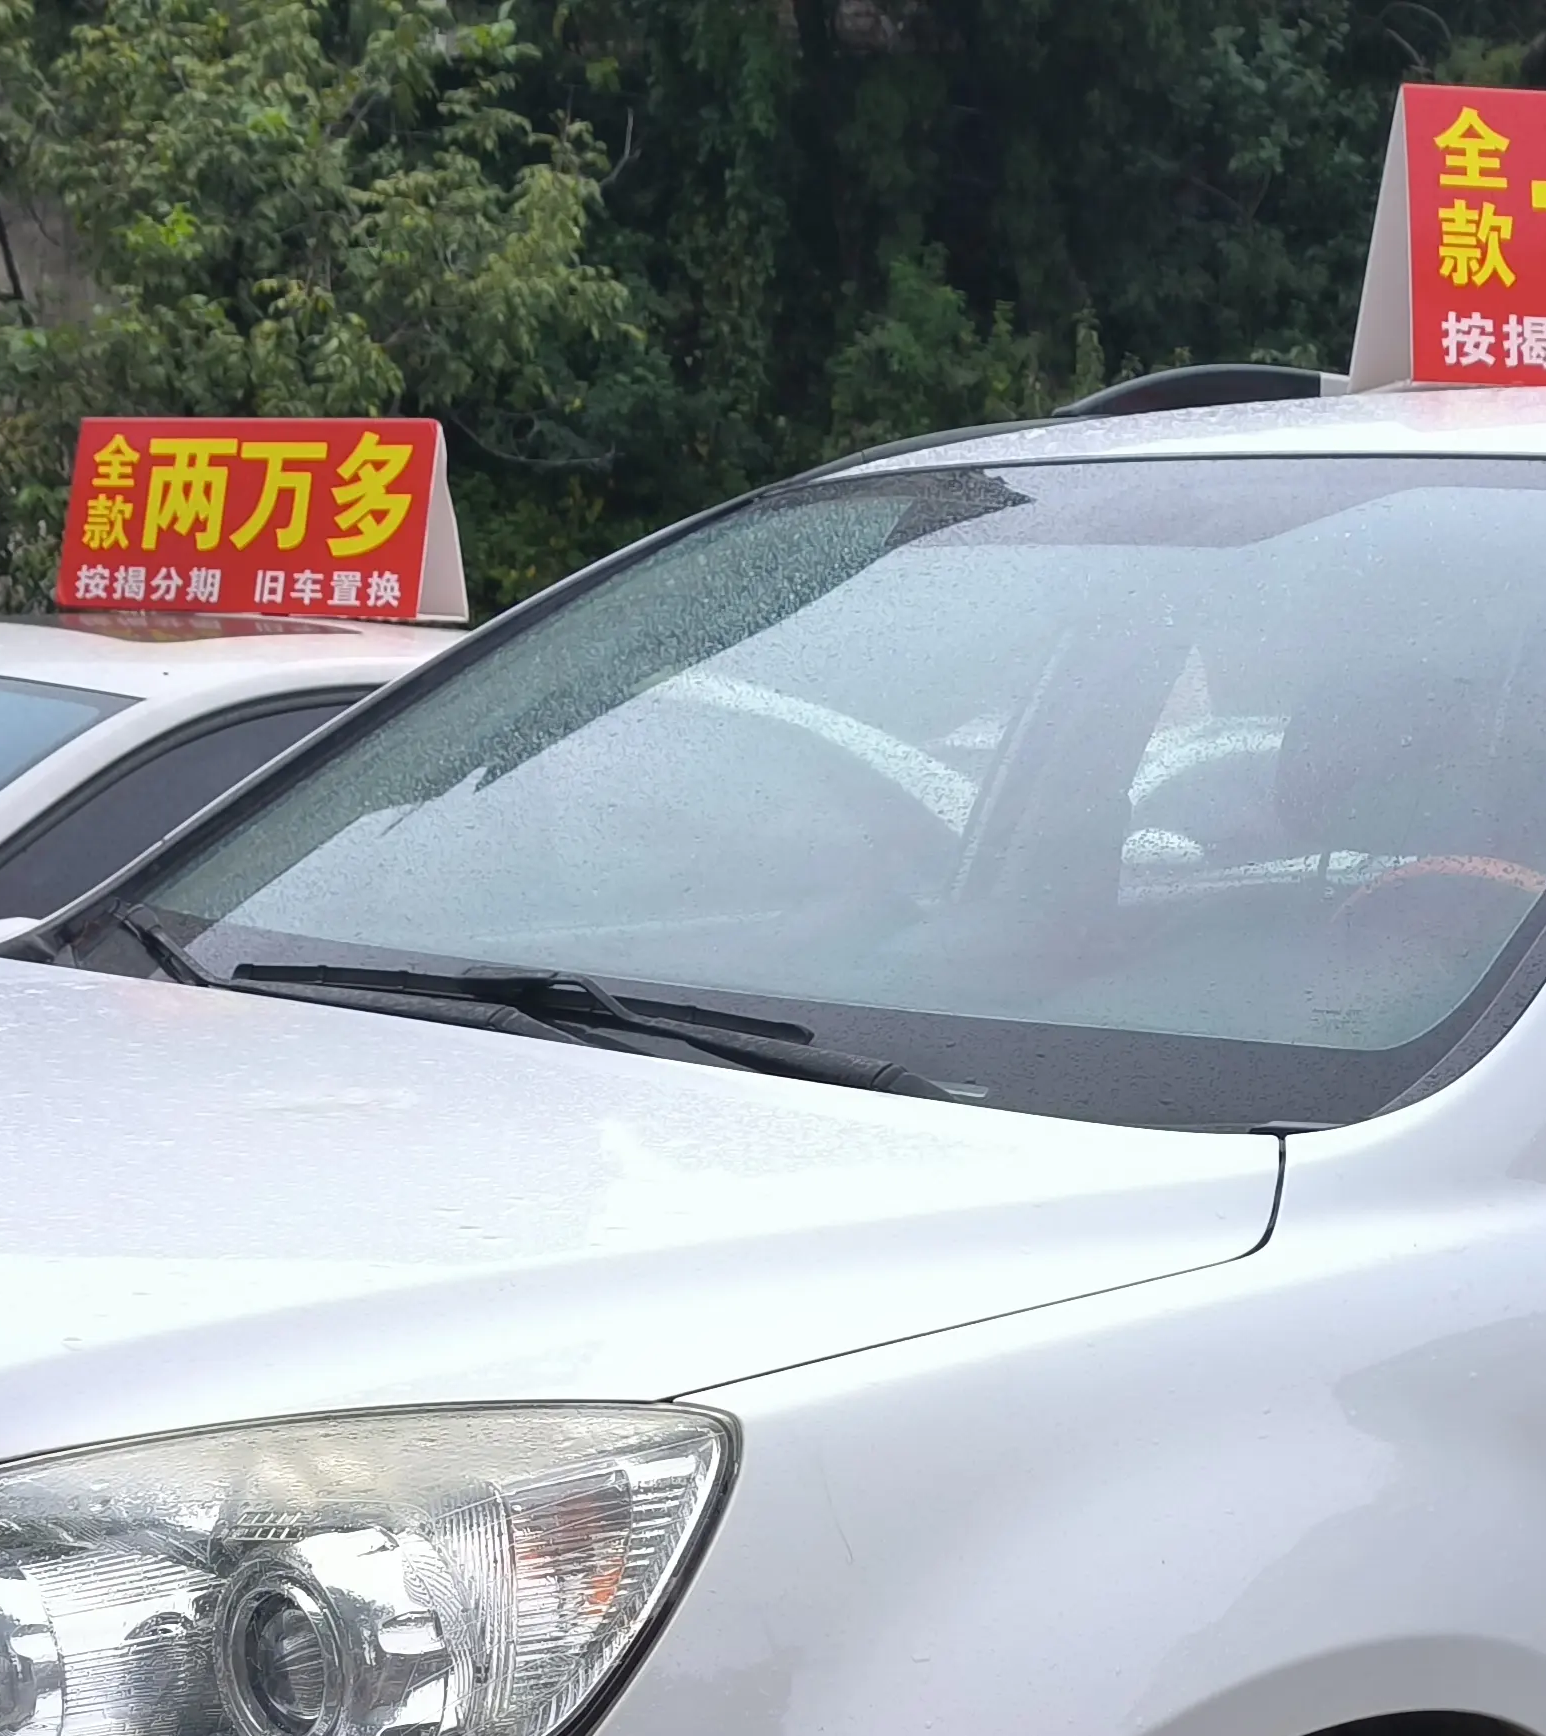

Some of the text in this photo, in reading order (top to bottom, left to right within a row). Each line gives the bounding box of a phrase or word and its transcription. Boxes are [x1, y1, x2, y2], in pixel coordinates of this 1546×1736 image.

[1433, 106, 1516, 288] 全款
[81, 433, 140, 551] 全款
[141, 430, 414, 558] 两万多
[75, 563, 402, 608] 按揭分期 旧车置换
